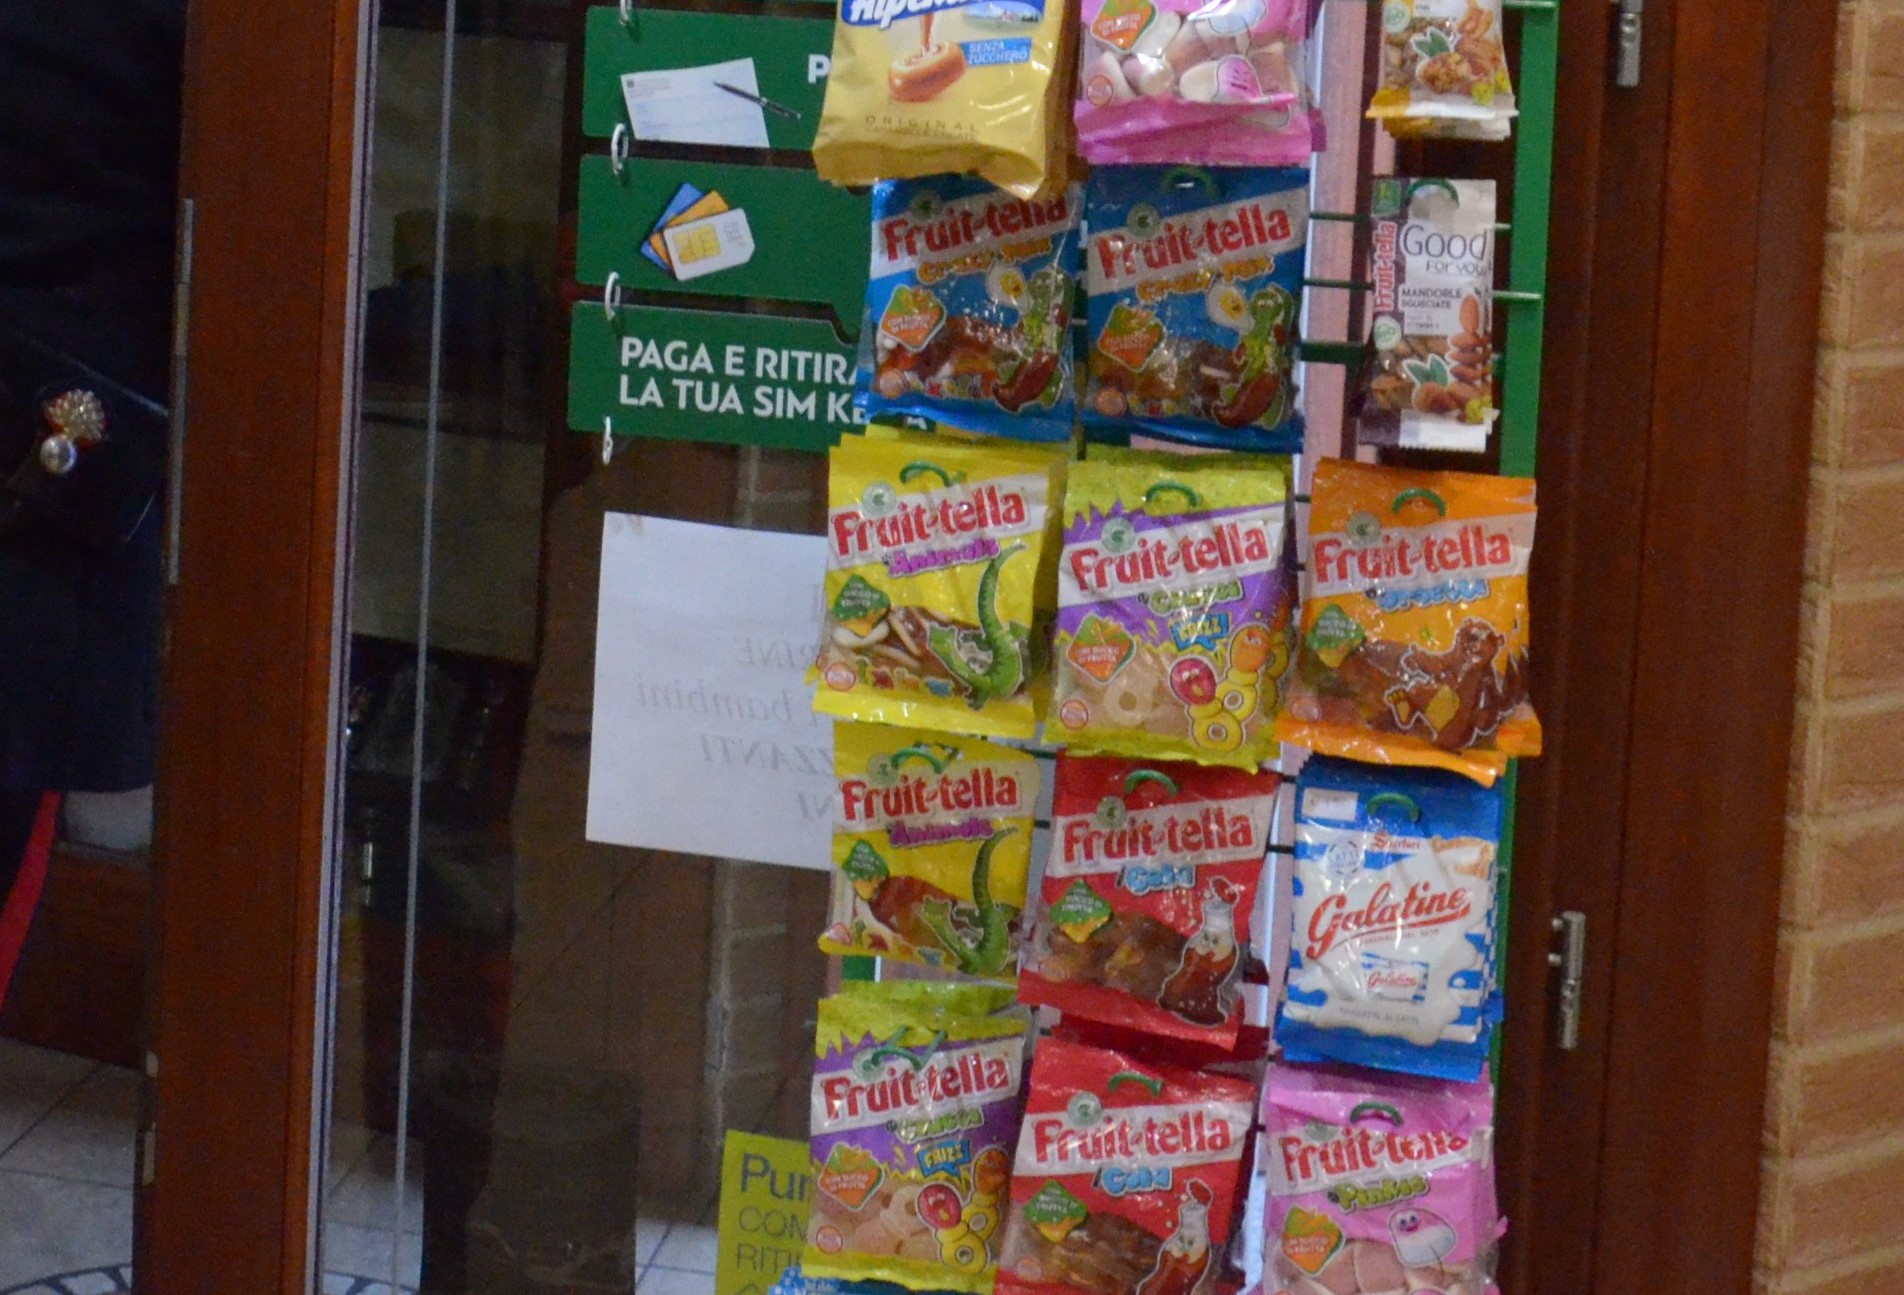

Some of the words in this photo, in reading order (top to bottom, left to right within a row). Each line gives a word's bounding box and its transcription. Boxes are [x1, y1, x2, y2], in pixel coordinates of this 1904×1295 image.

[1097, 203, 1291, 279] Fruit-tella
[1403, 224, 1487, 260] Good
[1402, 288, 1462, 299] MANDORLE
[621, 336, 714, 374] PAGA
[724, 344, 745, 376] E
[619, 374, 665, 408] LA
[672, 378, 744, 415] TUA
[753, 385, 816, 421] SIM
[832, 486, 1025, 555] Fruit-tella
[1070, 521, 1269, 591] Fruit-tella
[1313, 525, 1511, 584] Fruit-tella
[839, 768, 1017, 821] Fruit-tella
[1063, 807, 1253, 864] Fruit-tella
[1306, 881, 1471, 960] Galatine
[822, 1052, 1009, 1120] Fruit-tella
[1033, 1110, 1231, 1163] Fruit-tella
